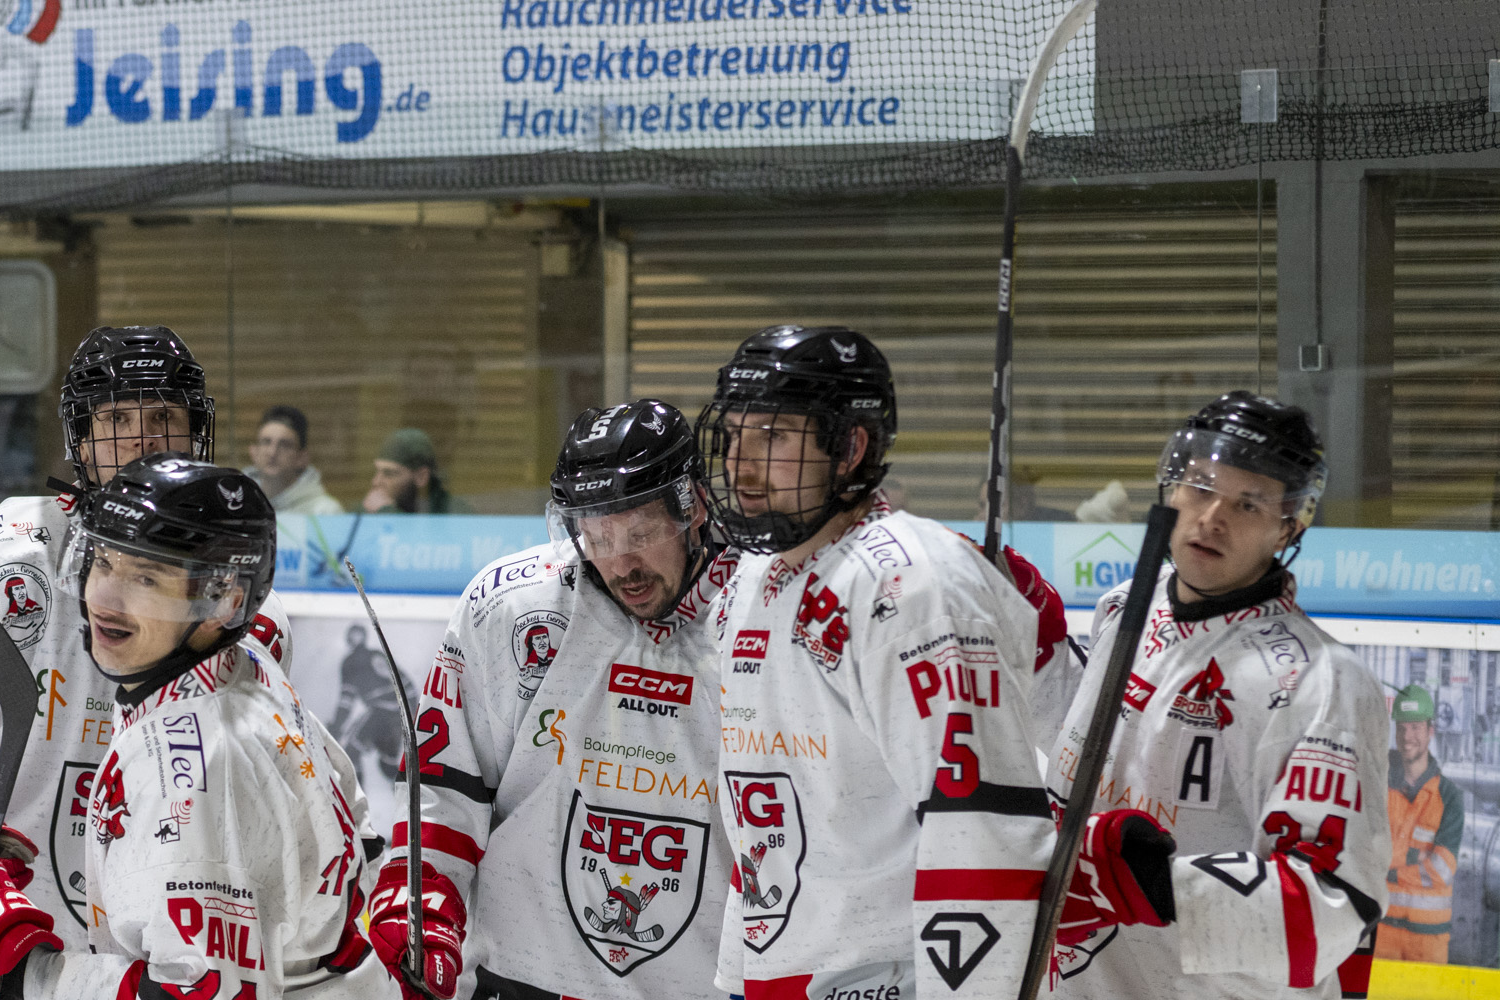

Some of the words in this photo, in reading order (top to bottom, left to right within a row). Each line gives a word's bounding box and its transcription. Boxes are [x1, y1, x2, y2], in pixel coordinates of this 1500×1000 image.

[501, 39, 851, 93] Objektbetreuung
[122, 359, 164, 369] CCM
[729, 369, 769, 380] CCM
[1221, 423, 1268, 444] CCM
[574, 478, 613, 492] CCM
[102, 501, 145, 520] CCM
[229, 555, 262, 565] CCM
[854, 525, 913, 571] SiTec
[466, 556, 540, 611] SiTec
[733, 637, 766, 652] CCM
[614, 672, 687, 697] CCM
[618, 697, 648, 714] ALL
[650, 702, 679, 718] OUT.
[162, 713, 207, 792] SiTec
[584, 737, 676, 764] Baumpflege
[934, 713, 980, 798] 5
[578, 759, 718, 804] FELDMA
[1179, 736, 1213, 802] A
[1275, 765, 1363, 813] AULI
[580, 812, 688, 873] SEG
[768, 833, 785, 849] 96
[1263, 811, 1347, 873] 24
[580, 856, 597, 873] 19
[661, 878, 679, 893] 96
[434, 953, 444, 986] CCM
